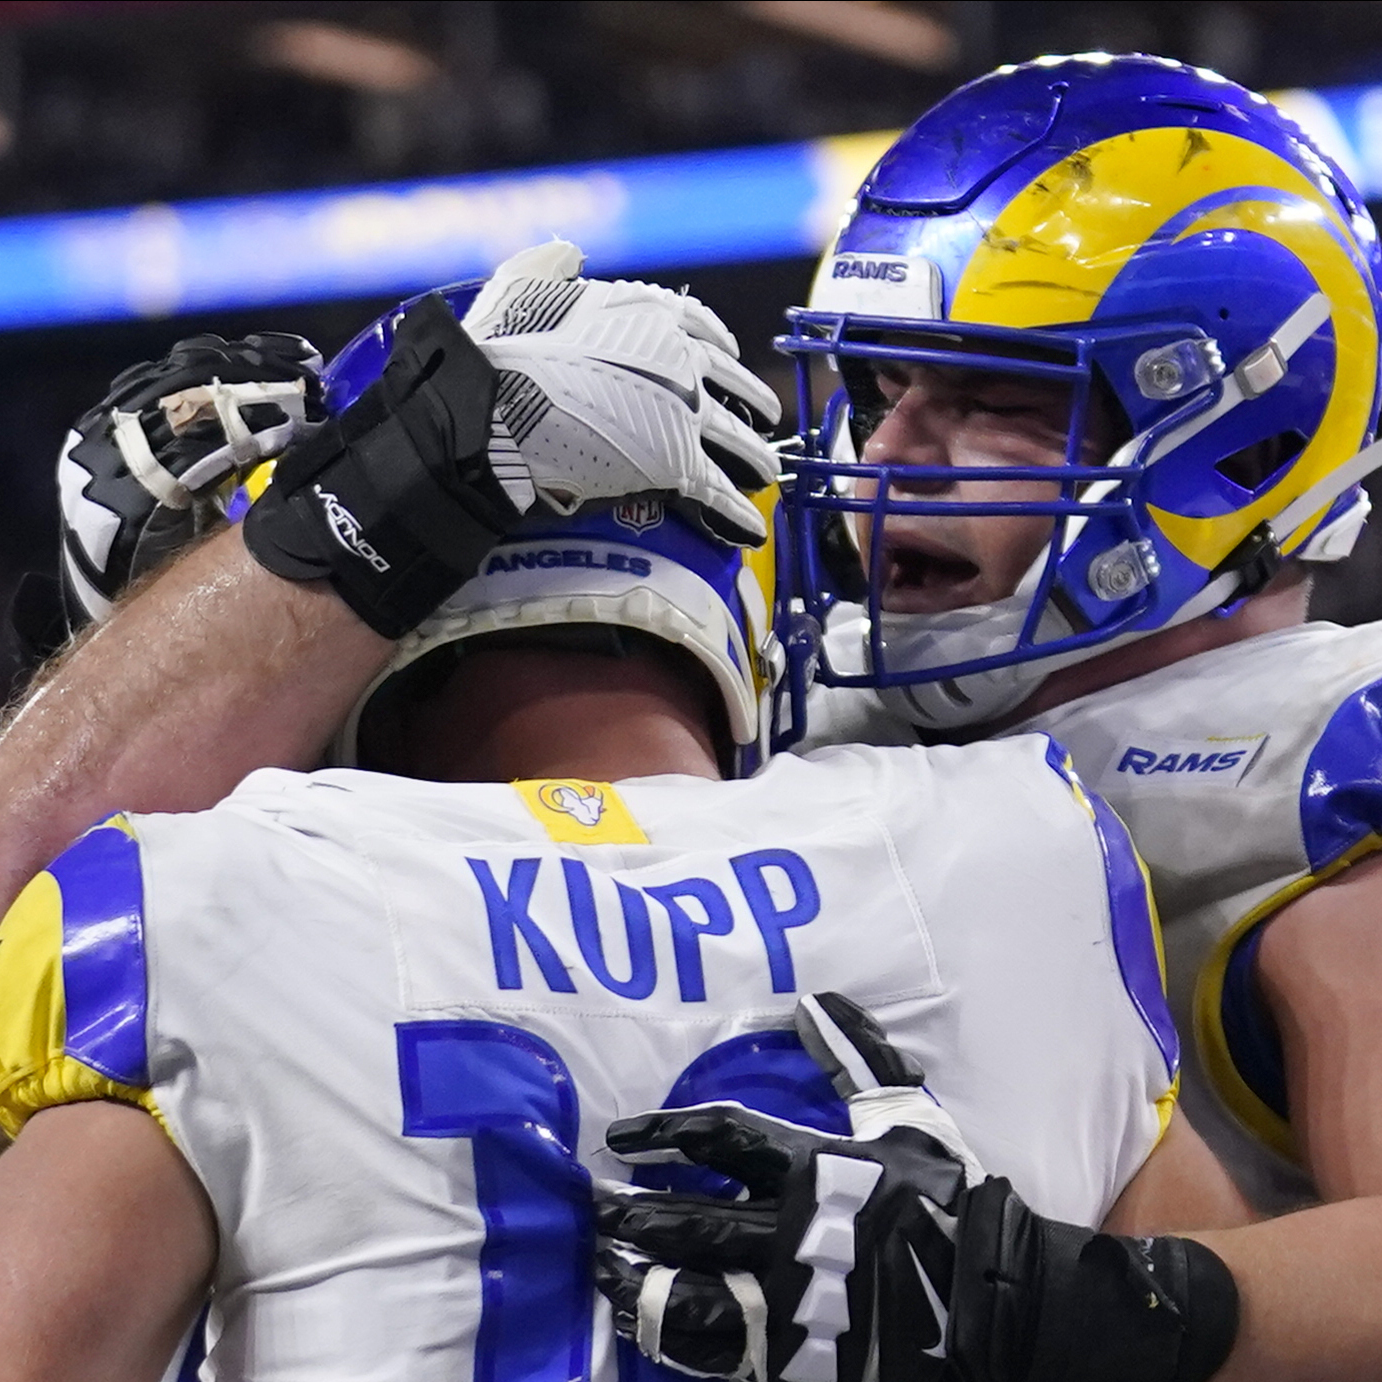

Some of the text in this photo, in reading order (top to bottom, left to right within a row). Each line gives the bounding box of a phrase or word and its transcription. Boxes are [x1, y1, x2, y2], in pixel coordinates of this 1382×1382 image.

[832, 260, 909, 282] RAMS
[621, 500, 659, 523] NFL
[486, 550, 653, 577] ANGELES
[1116, 746, 1247, 776] RAMS
[465, 847, 821, 1003] KUPP
